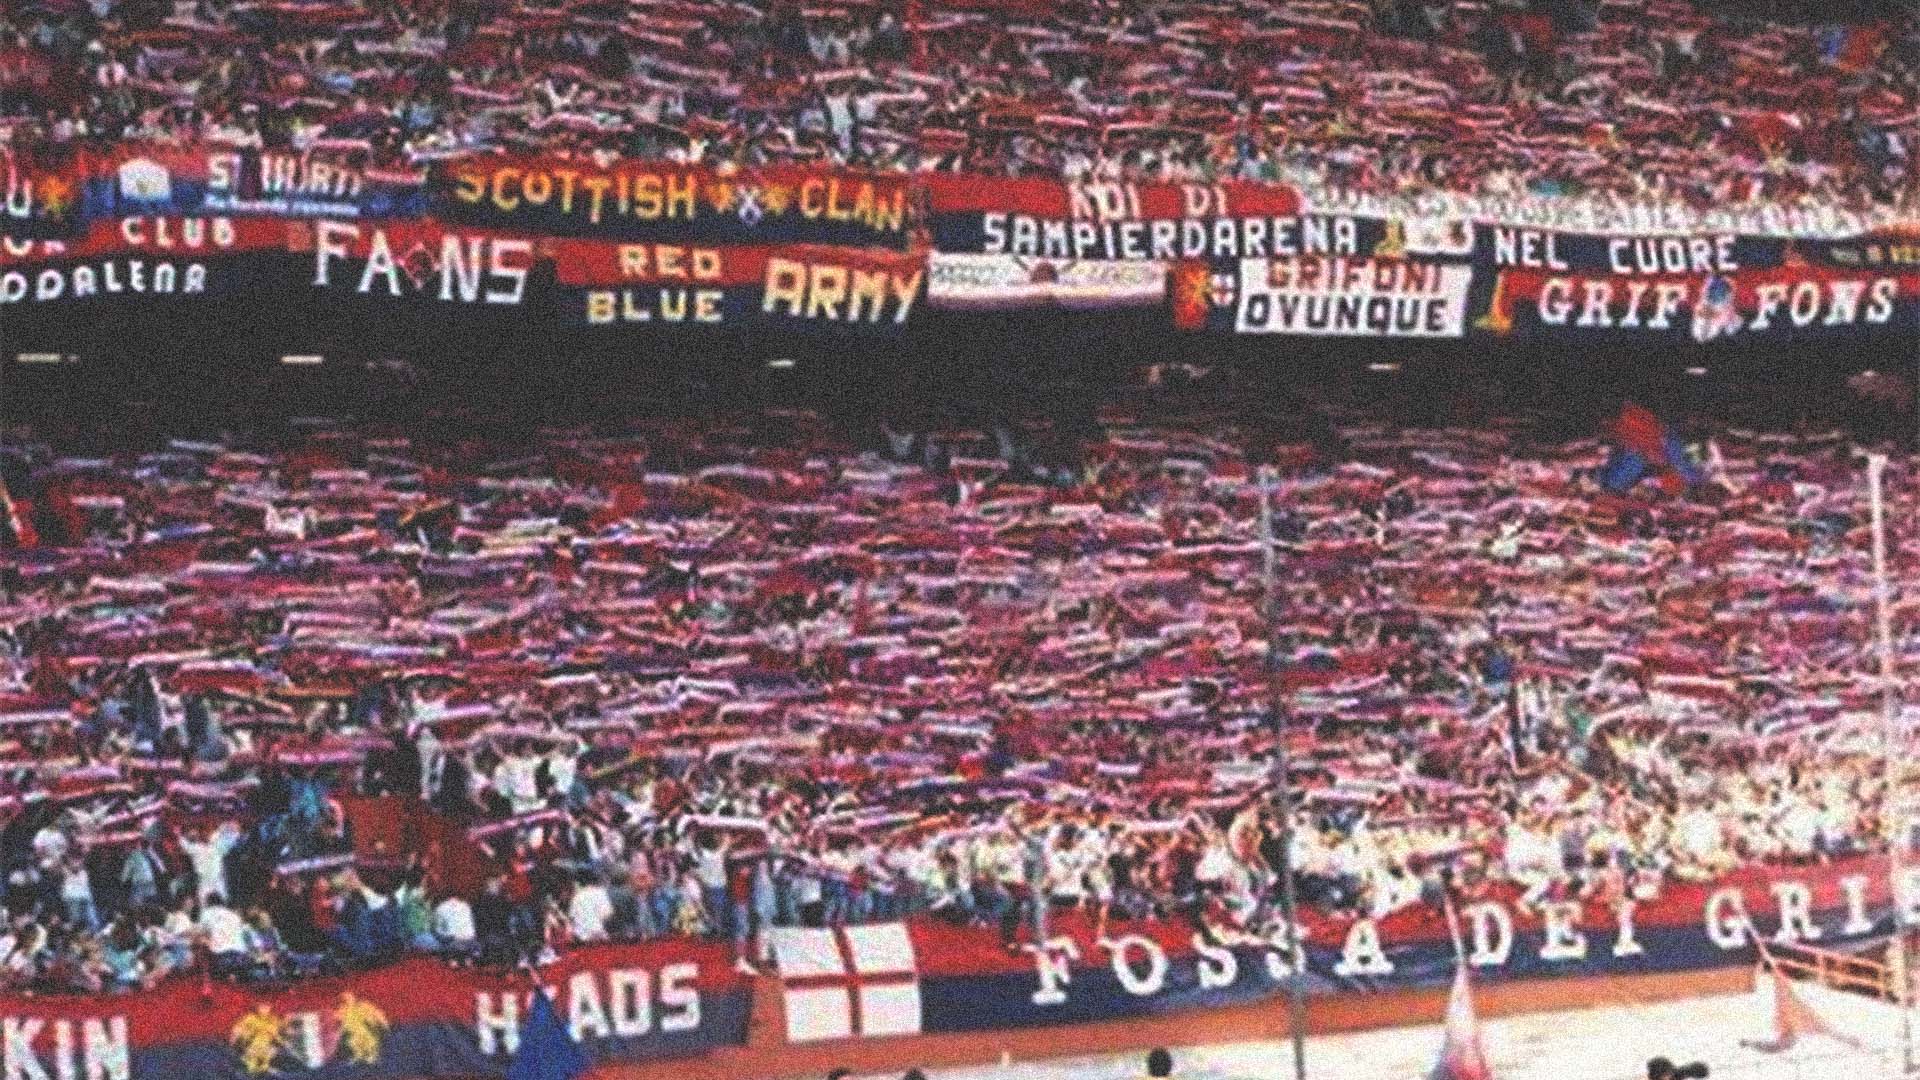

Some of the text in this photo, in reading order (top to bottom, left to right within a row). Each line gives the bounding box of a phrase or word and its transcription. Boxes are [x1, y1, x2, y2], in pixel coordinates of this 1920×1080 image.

[456, 167, 905, 232] SCOTTISH CLAN
[983, 212, 1357, 261] SAMPIERDARENA
[1495, 229, 1739, 275] NEL CUORE
[618, 245, 722, 280] RED
[1266, 256, 1443, 295] GRIFONI
[587, 290, 724, 325] BLUE
[762, 256, 924, 324] ARMY
[1244, 294, 1450, 335] OVUNQUE
[1467, 895, 1645, 966] DEI
[475, 962, 702, 1056] HADS
[2, 1015, 130, 1080] KIN
